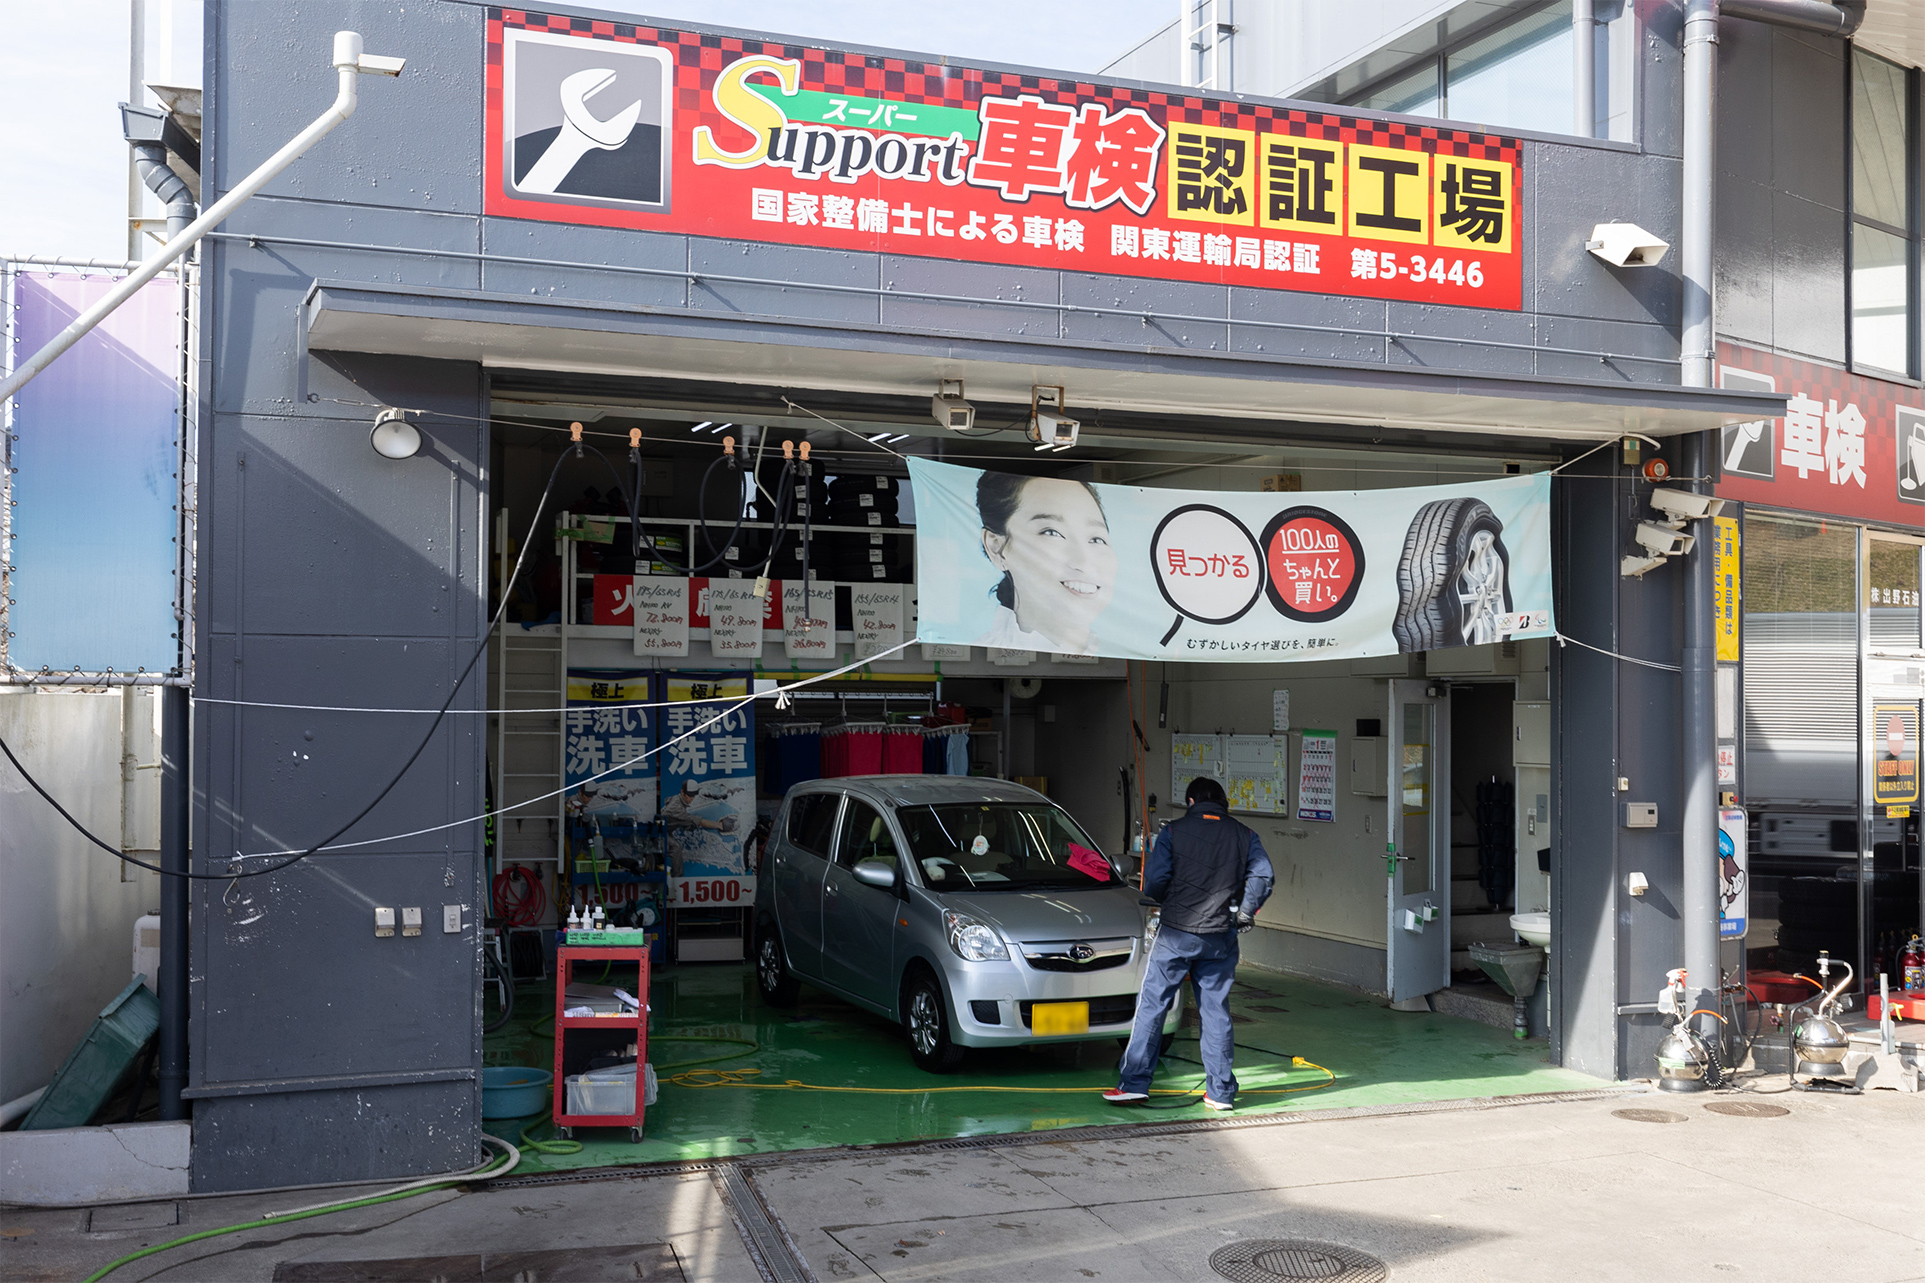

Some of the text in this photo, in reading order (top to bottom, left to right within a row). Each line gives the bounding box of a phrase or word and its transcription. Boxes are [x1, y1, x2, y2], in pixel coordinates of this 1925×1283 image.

[822, 98, 917, 126] スーパー
[693, 54, 1507, 244] Support 車検 認証工場
[752, 188, 1484, 288] 国家整備士による車検 関東運輸局認証 第5-3446
[1781, 392, 1867, 489] 車検
[1279, 528, 1339, 550] 100人の
[1167, 548, 1250, 579] 見つかる
[1283, 558, 1341, 580] ちゃんと
[1294, 581, 1339, 605] 買い。
[1186, 637, 1340, 651] むずかしいタイヤ選びを、簡単に。
[590, 682, 625, 700] 極上
[690, 683, 724, 700] 極上
[566, 707, 648, 734] 手洗い
[667, 708, 748, 735] 手洗い
[566, 735, 649, 776] 洗車
[668, 736, 748, 776] 洗車
[1878, 759, 1915, 777] STAFF ONLY
